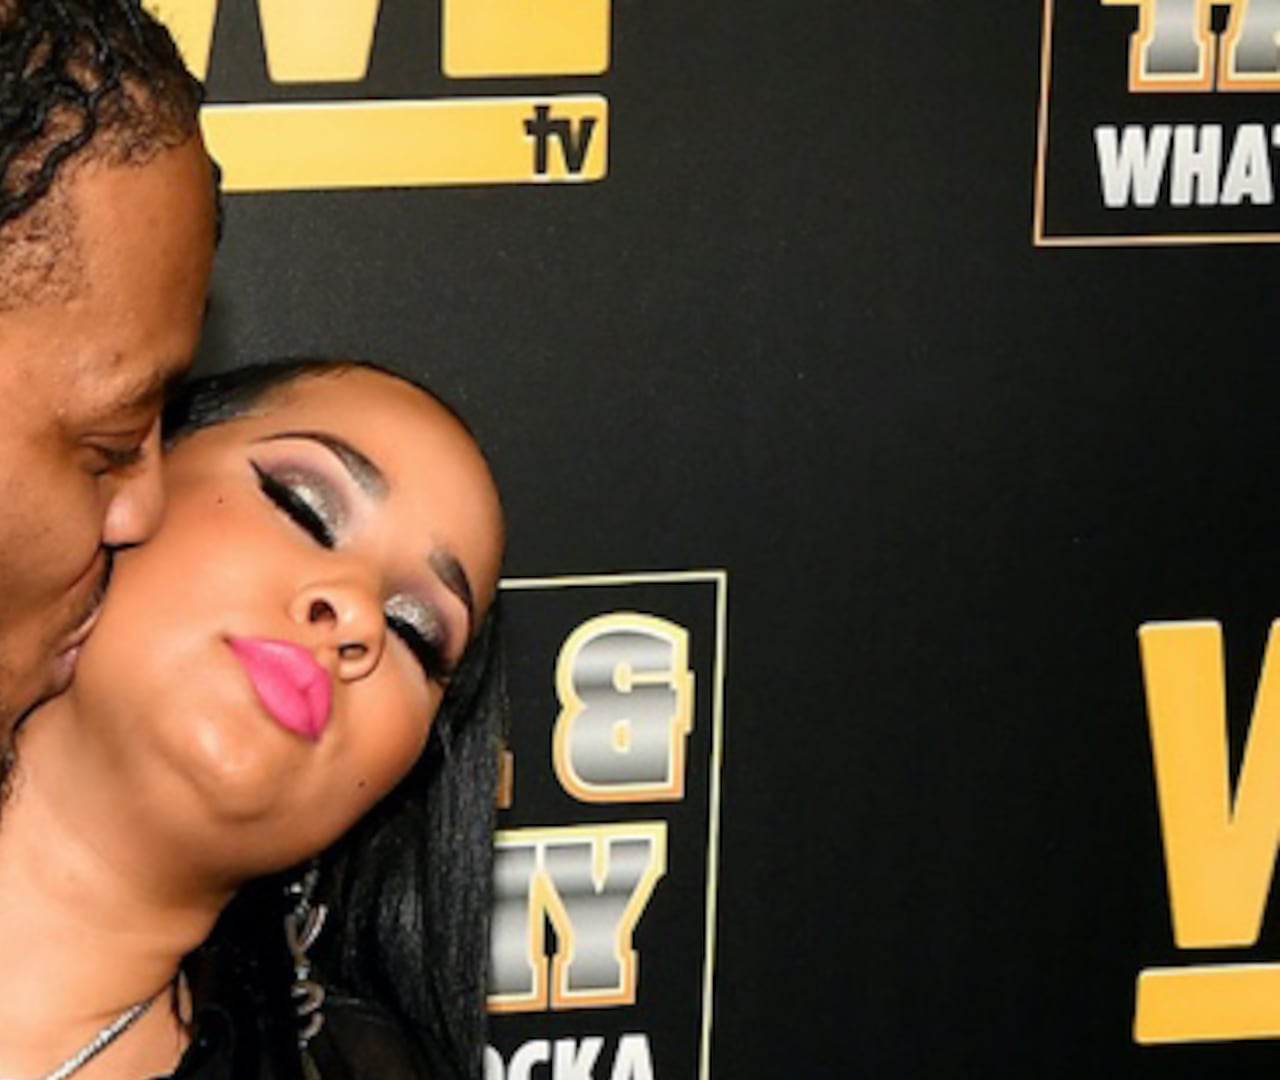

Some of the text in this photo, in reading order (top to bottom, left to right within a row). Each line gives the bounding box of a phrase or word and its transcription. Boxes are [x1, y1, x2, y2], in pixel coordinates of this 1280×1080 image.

[523, 104, 597, 175] tv
[1094, 124, 1280, 208] WHA
[552, 612, 694, 802] &
